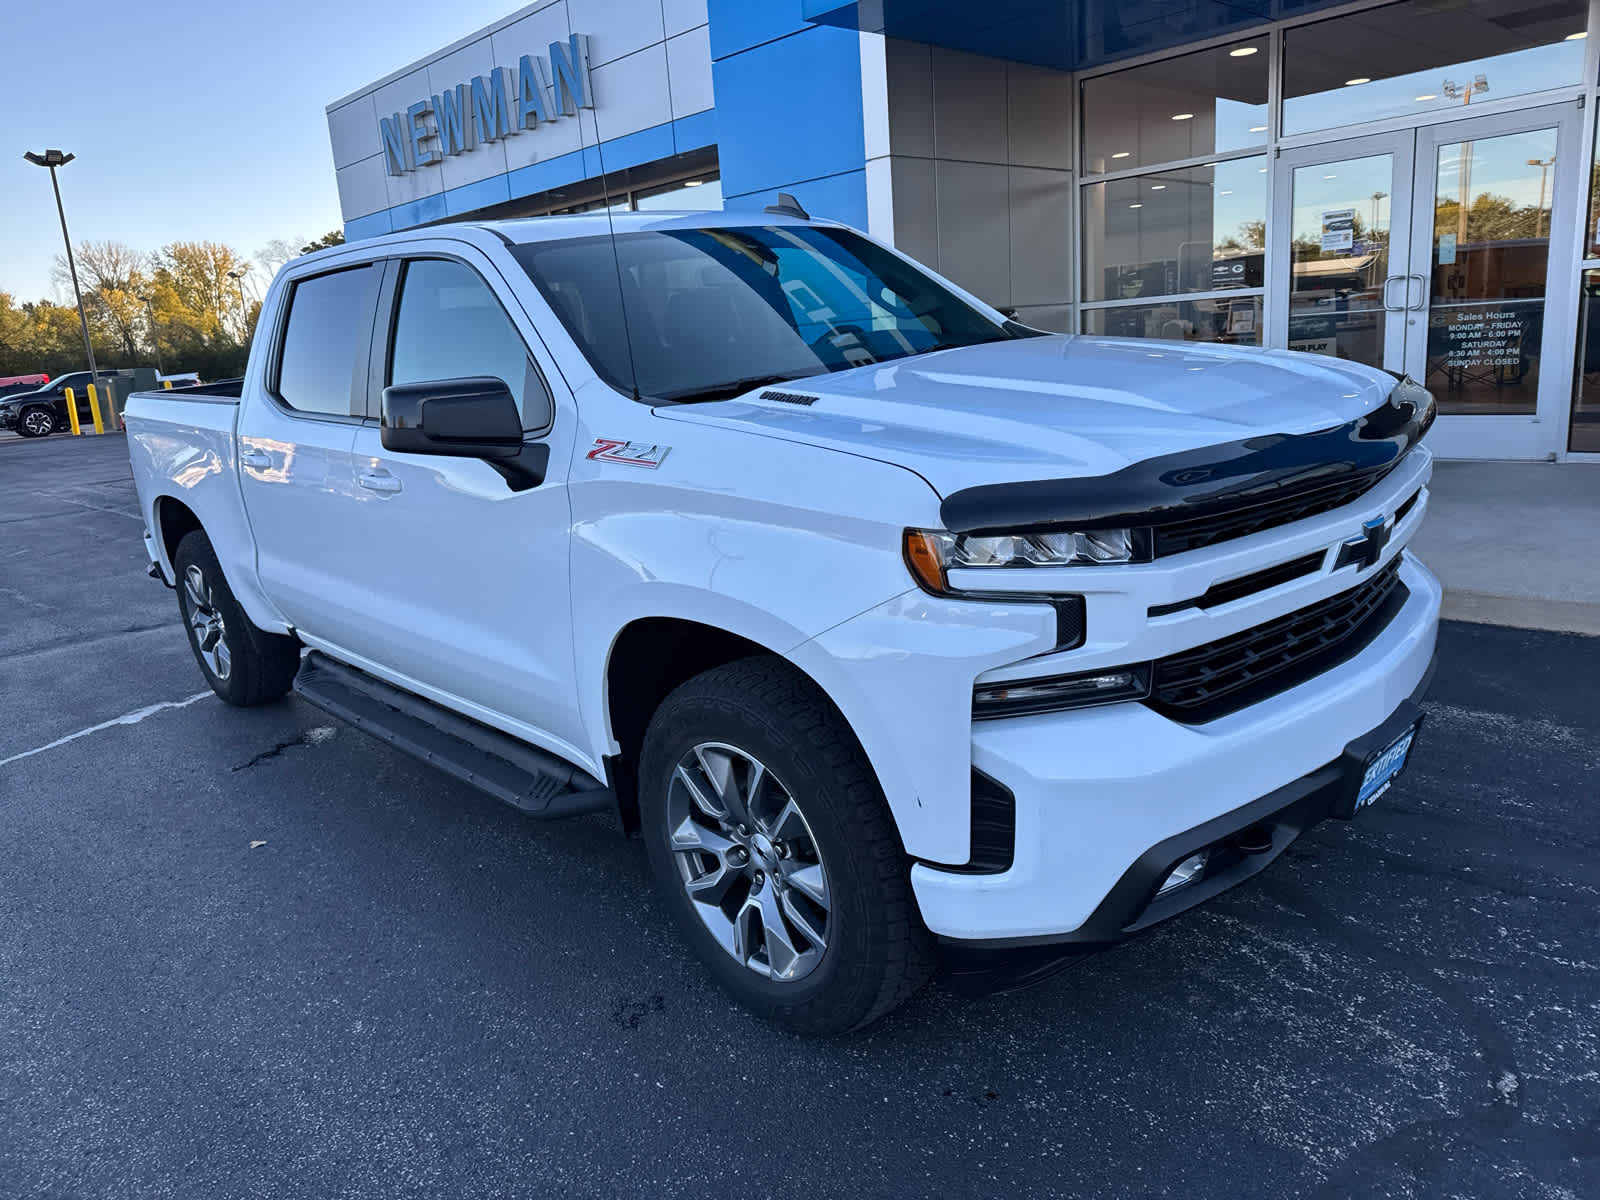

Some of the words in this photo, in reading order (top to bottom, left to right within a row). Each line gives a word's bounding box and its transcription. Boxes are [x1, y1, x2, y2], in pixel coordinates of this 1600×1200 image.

[380, 33, 593, 176] NEWMAN
[1456, 313, 1482, 321] Sales
[1486, 311, 1515, 320] Hours
[1448, 323, 1485, 332] MONDAY
[1491, 321, 1523, 330] FRIDAY
[1449, 332, 1467, 340] 9:00
[1467, 331, 1481, 339] AM
[1488, 330, 1506, 338] 6:00
[1507, 329, 1521, 337] PM
[1461, 340, 1508, 349] SATURDAY
[1487, 348, 1505, 356] 4:00
[1448, 359, 1482, 367] SUNDAY
[1483, 358, 1520, 366] CLOSED
[585, 439, 673, 470] Z71
[1361, 735, 1412, 788] ERTIFIED
